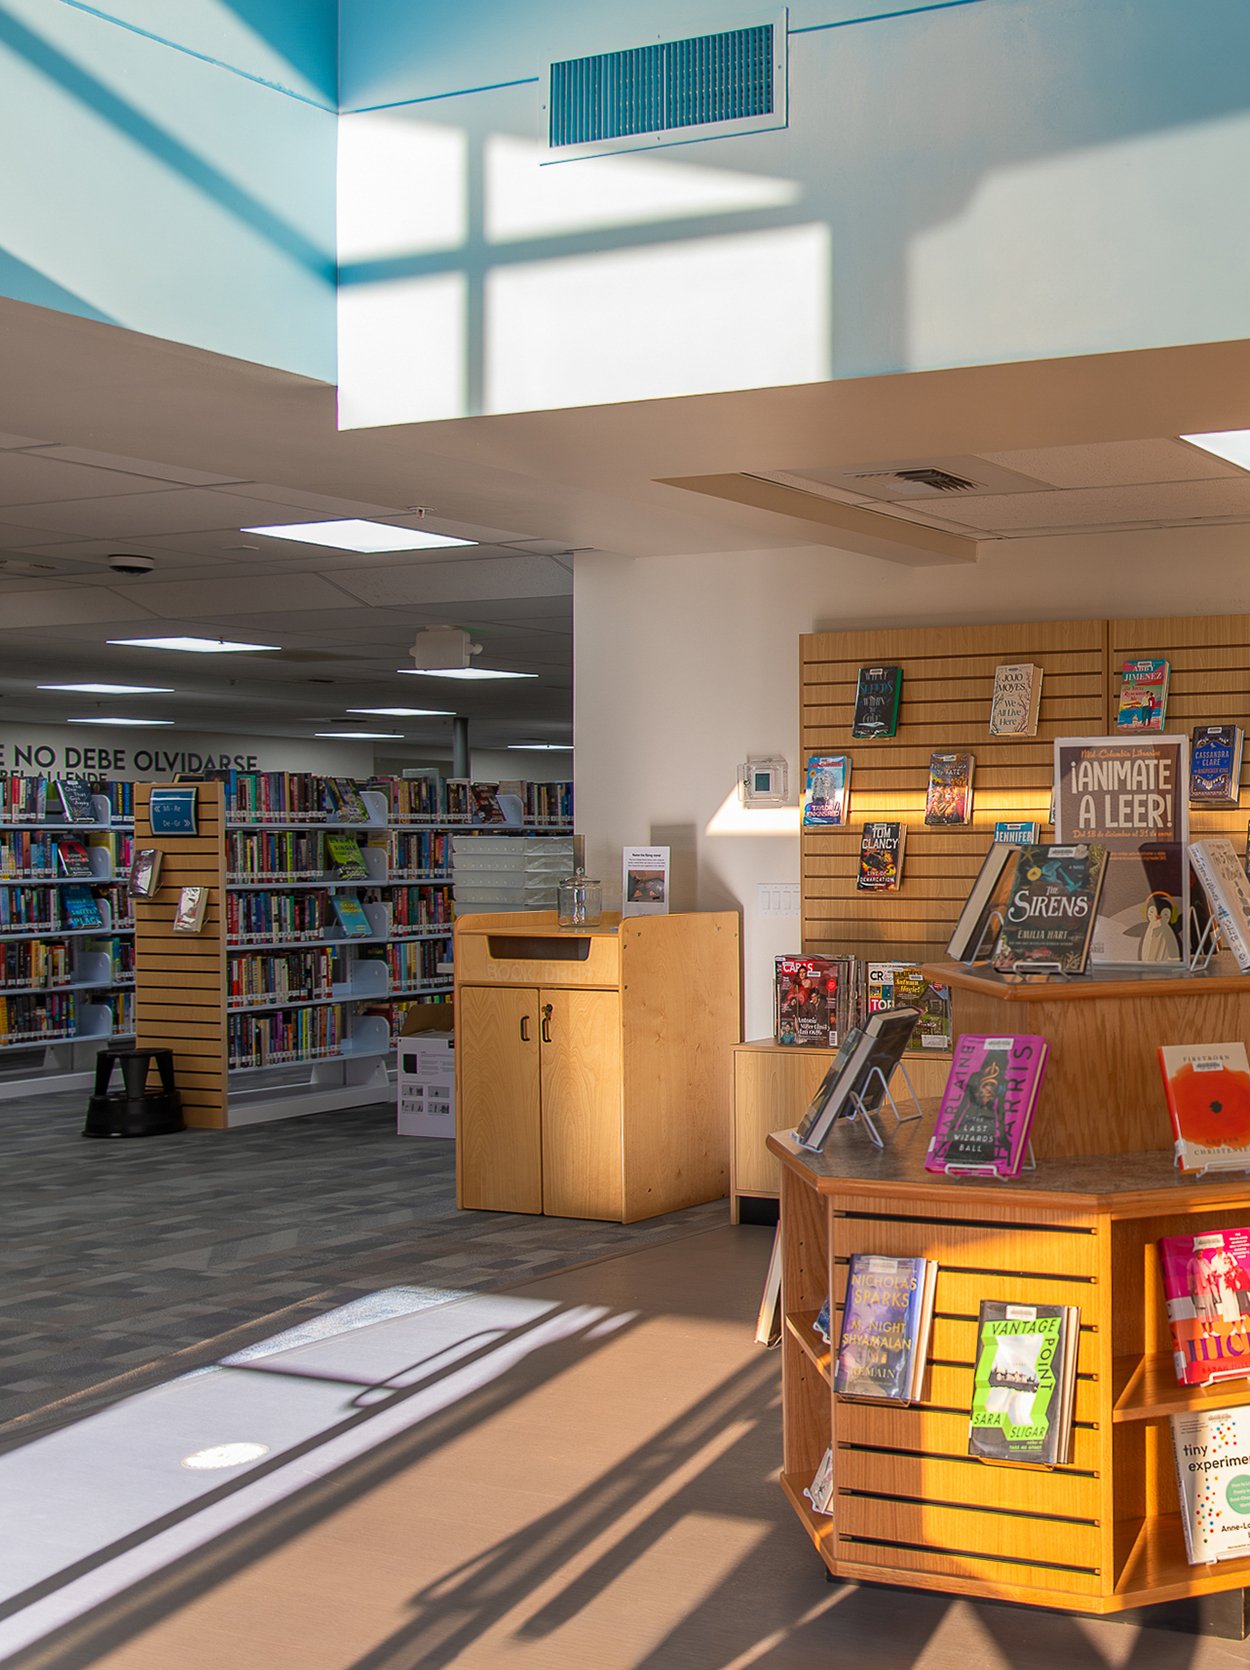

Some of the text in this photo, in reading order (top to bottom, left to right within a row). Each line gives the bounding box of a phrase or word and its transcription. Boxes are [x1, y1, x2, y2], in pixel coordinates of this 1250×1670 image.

[1002, 673, 1023, 682] JOJO
[1125, 672, 1162, 682] JIMENEZ
[997, 683, 1025, 693] MOYES
[14, 744, 56, 769] NO
[65, 747, 126, 772] DEBE
[134, 750, 258, 773] OLVIDARSE
[1195, 750, 1230, 760] CASSANDRA
[1201, 759, 1221, 767] CLARE
[1079, 793, 1173, 829] A LEER!
[873, 828, 891, 839] TOM
[994, 831, 1033, 842] JENNIFER
[862, 838, 899, 849] CLANCY
[1046, 886, 1060, 896] THE
[1008, 890, 1088, 922] SIRENS
[1017, 930, 1068, 940] EMILIA HART
[487, 964, 591, 981] BOOK DROP
[1182, 1055, 1231, 1063] FIRSTBORN
[995, 1046, 1033, 1167] HARRIS
[958, 1144, 982, 1152] BALL
[851, 1274, 917, 1291] NICHOLAS
[854, 1290, 910, 1308] SPARKS
[851, 1320, 907, 1334] M. NIGHT
[991, 1319, 1057, 1335] VANTAGE
[842, 1333, 911, 1350] SHYAMALAN
[1037, 1337, 1056, 1392] POINT
[851, 1366, 897, 1379] REMAIN
[974, 1413, 1002, 1425] SARA
[1010, 1426, 1046, 1439] SLIGAR
[1183, 1444, 1208, 1457] tiny
